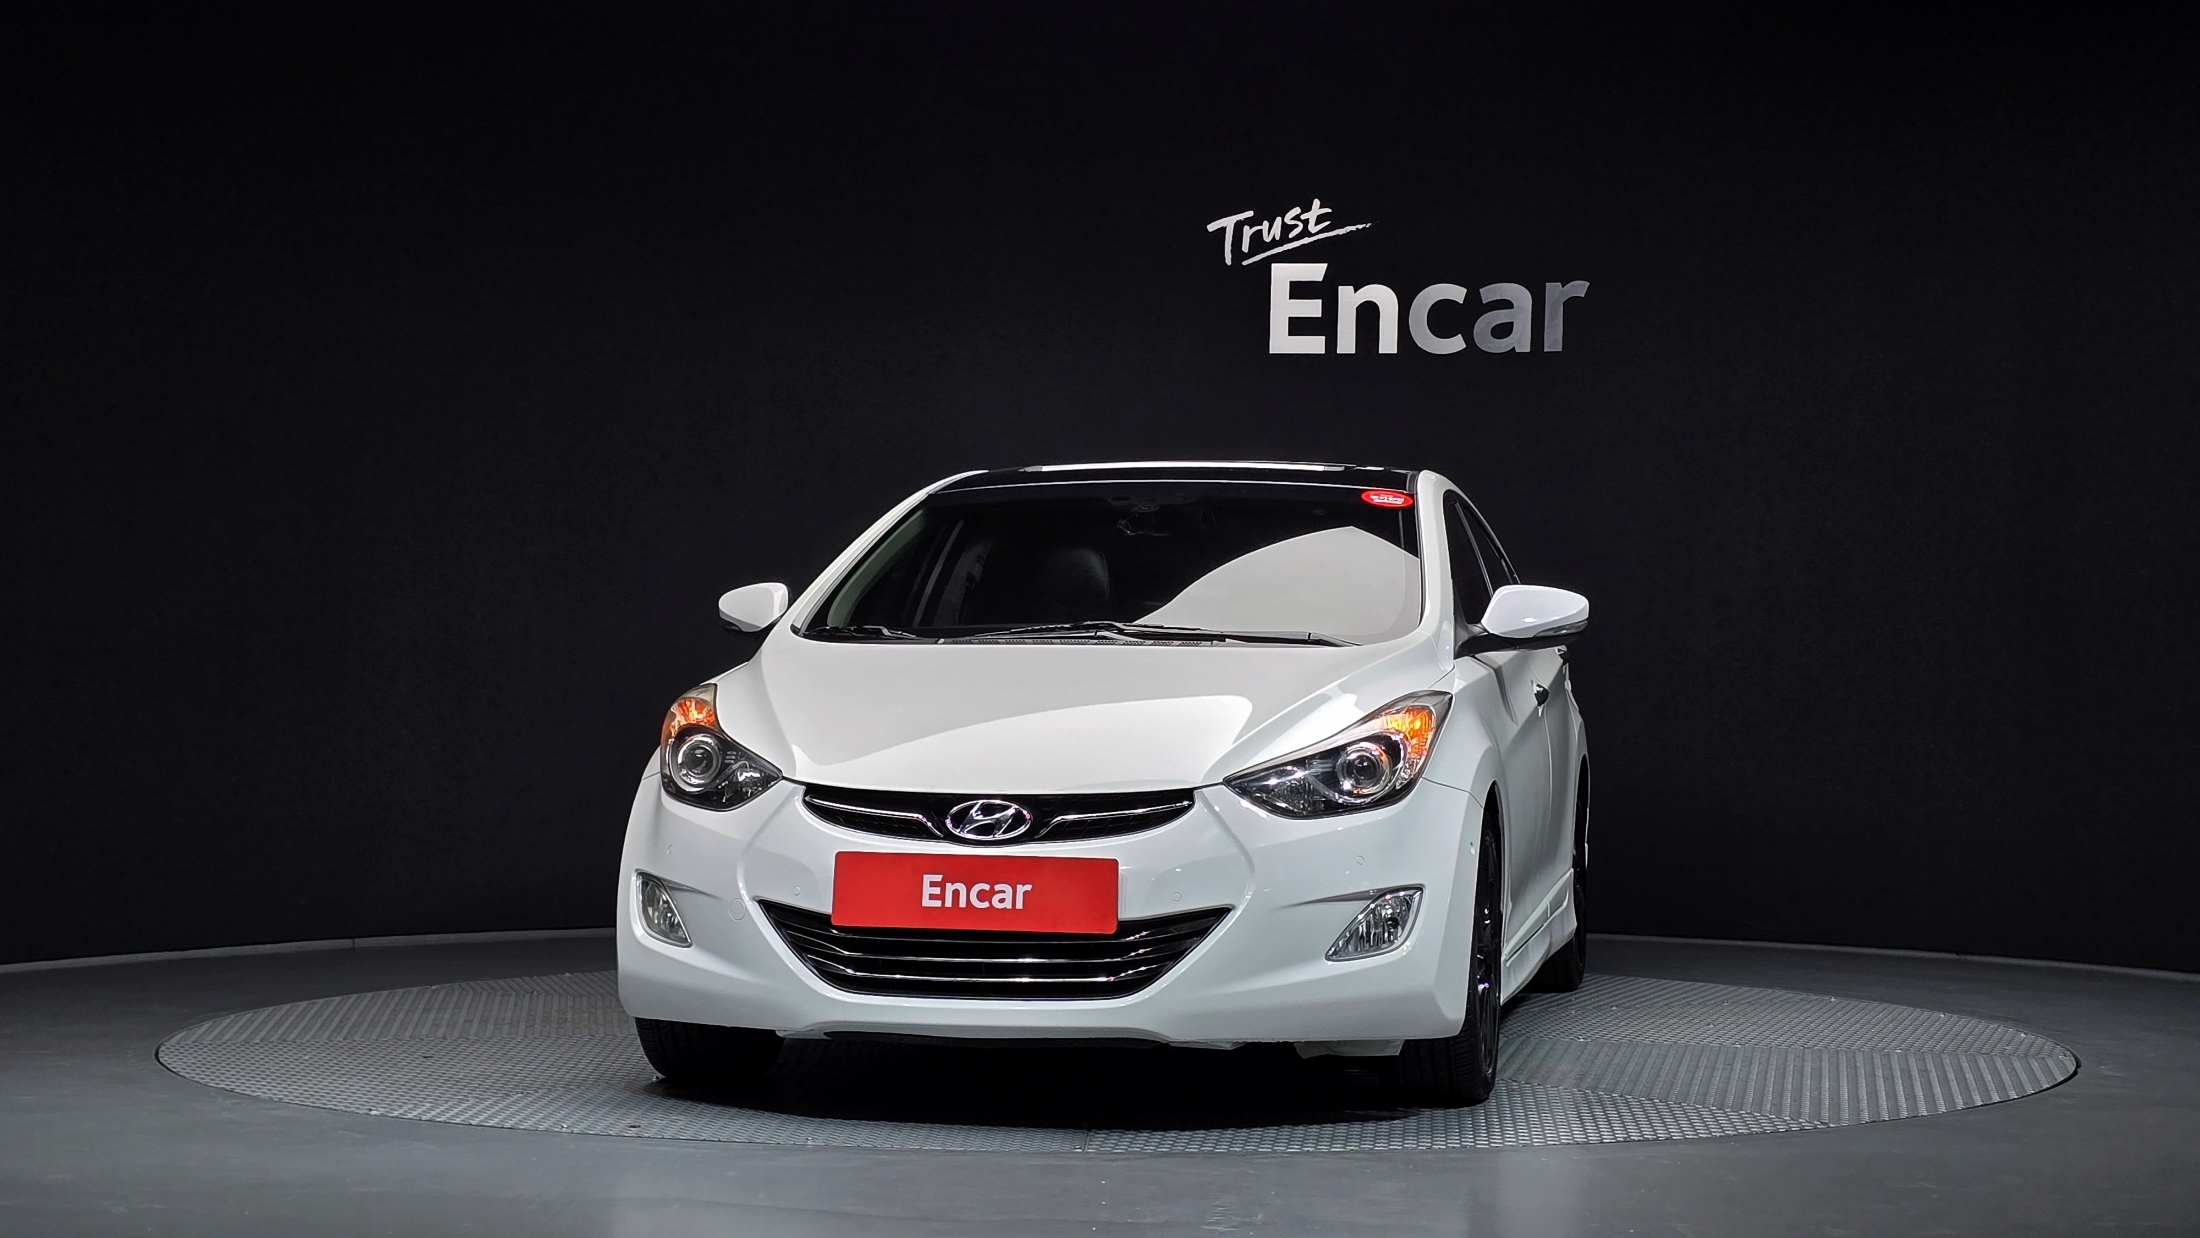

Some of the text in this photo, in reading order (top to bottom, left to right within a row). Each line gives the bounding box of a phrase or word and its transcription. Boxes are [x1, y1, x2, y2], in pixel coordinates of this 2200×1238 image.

[1207, 198, 1333, 266] Trust
[1268, 262, 1591, 355] Encar
[920, 874, 1033, 910] Encar
